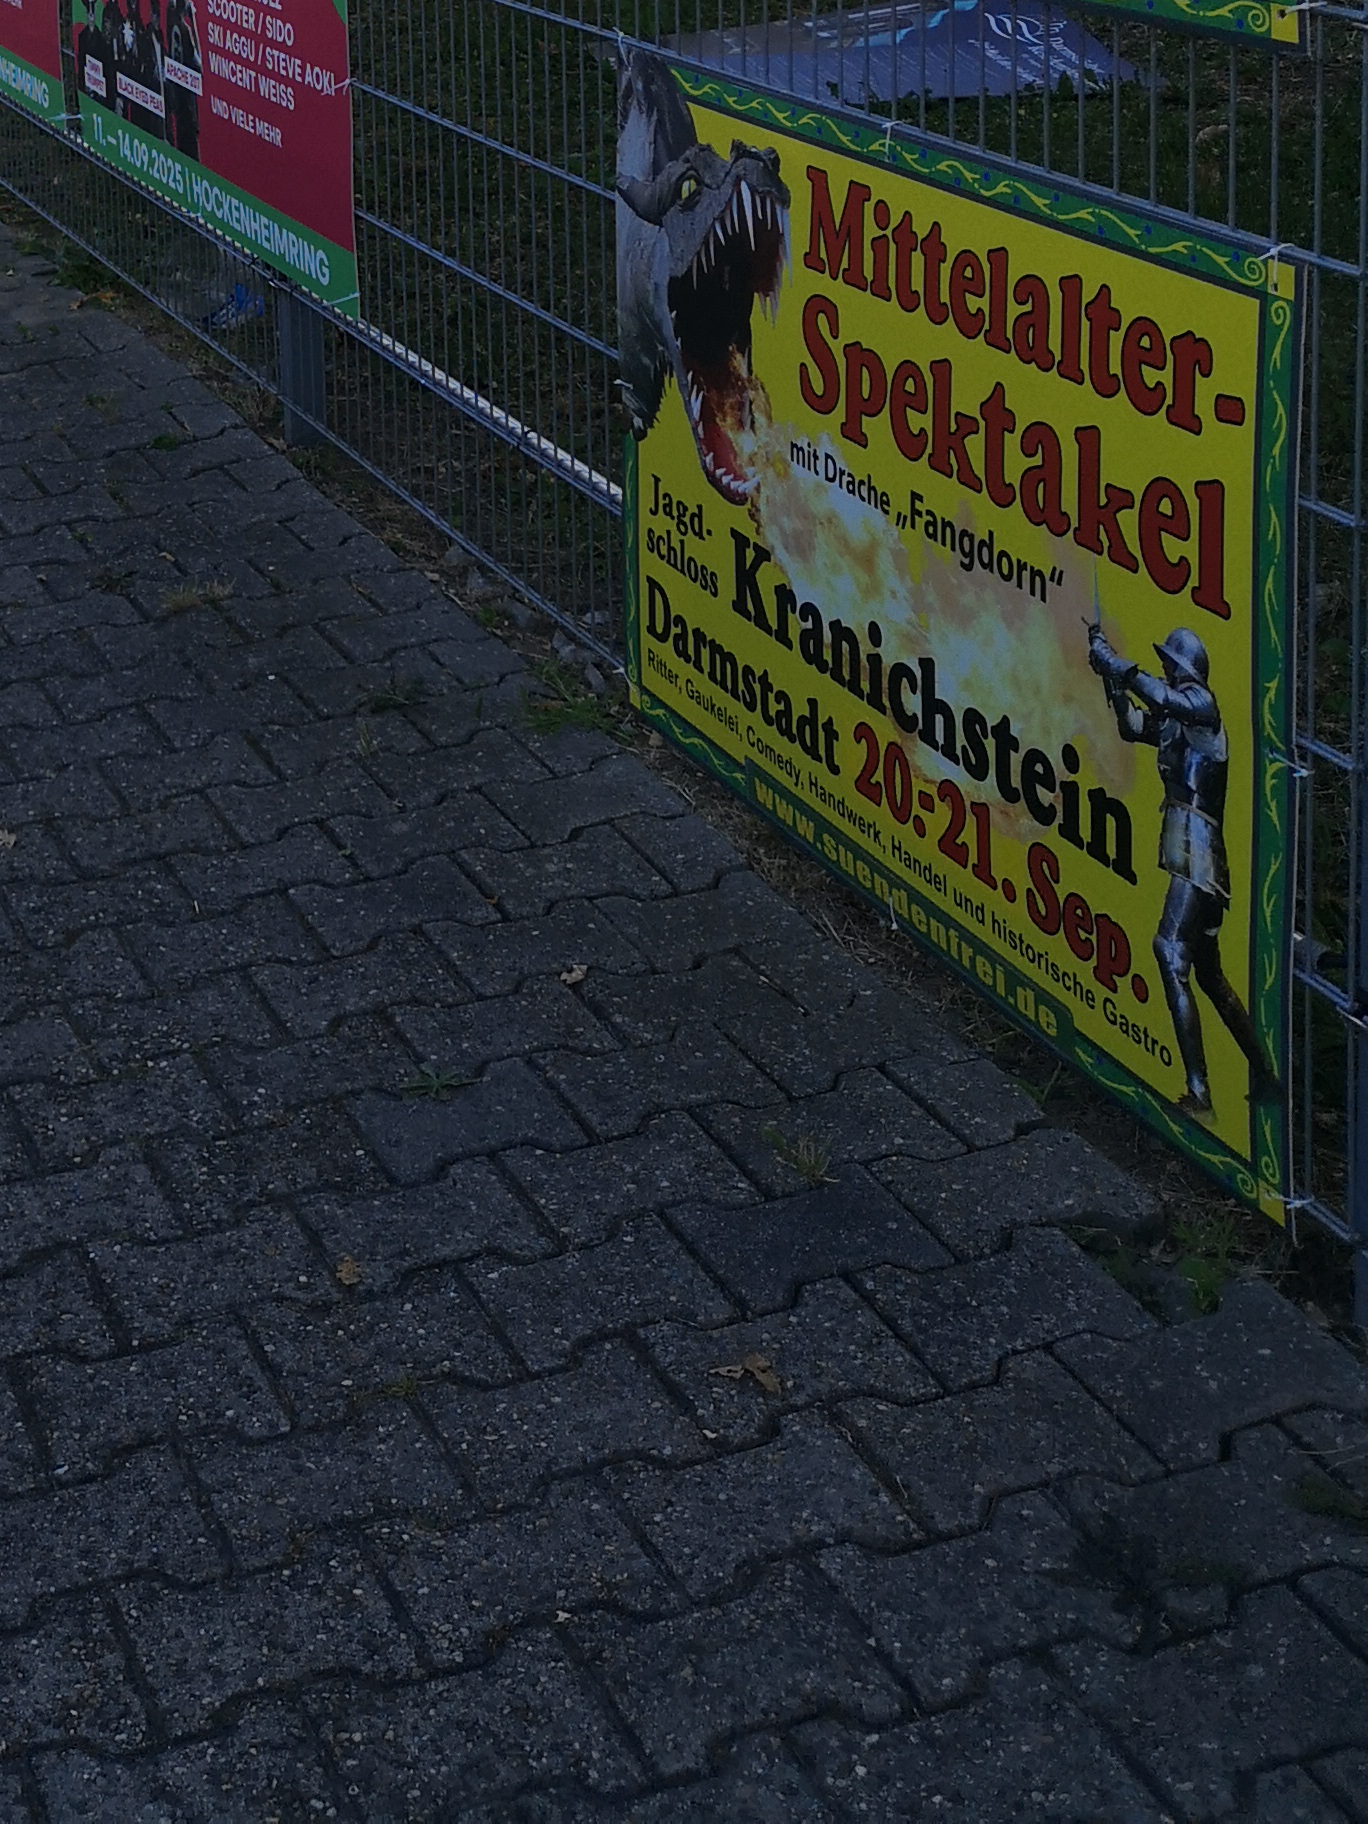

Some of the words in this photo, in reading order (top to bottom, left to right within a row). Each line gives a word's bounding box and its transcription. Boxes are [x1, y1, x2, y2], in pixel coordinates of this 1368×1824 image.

[207, 21, 224, 48] SKI
[224, 29, 255, 62] AGGU
[265, 46, 303, 83] STEVE
[304, 62, 336, 97] AOKI
[265, 15, 295, 47] SIDO
[208, 50, 257, 93] WINCENT
[257, 73, 295, 111] WEISS
[210, 94, 230, 120] UND
[229, 105, 255, 134] VIELE
[255, 117, 282, 148] MEHR
[191, 172, 330, 286] HOCKENHEIMRING
[802, 164, 1246, 437] Mittelalter-
[790, 440, 820, 476] mit
[824, 452, 891, 516] Drache
[799, 293, 1232, 621] Spektakel
[649, 473, 713, 542] Jagd-
[646, 527, 719, 599] schloss
[729, 525, 1138, 886] Kranichstein
[645, 573, 841, 777] Darmstadt
[1026, 841, 1149, 1005] Sep.
[647, 647, 683, 696] Ritter,
[685, 677, 743, 742] Gaukelei,
[745, 724, 805, 791] Comedy,
[808, 771, 887, 855] Handwerk,
[891, 834, 947, 897] Handel
[952, 887, 986, 927] und
[991, 910, 1096, 1011] historische
[1102, 996, 1173, 1068] Gastro
[754, 777, 1060, 1037] www.suendenfrei.de
